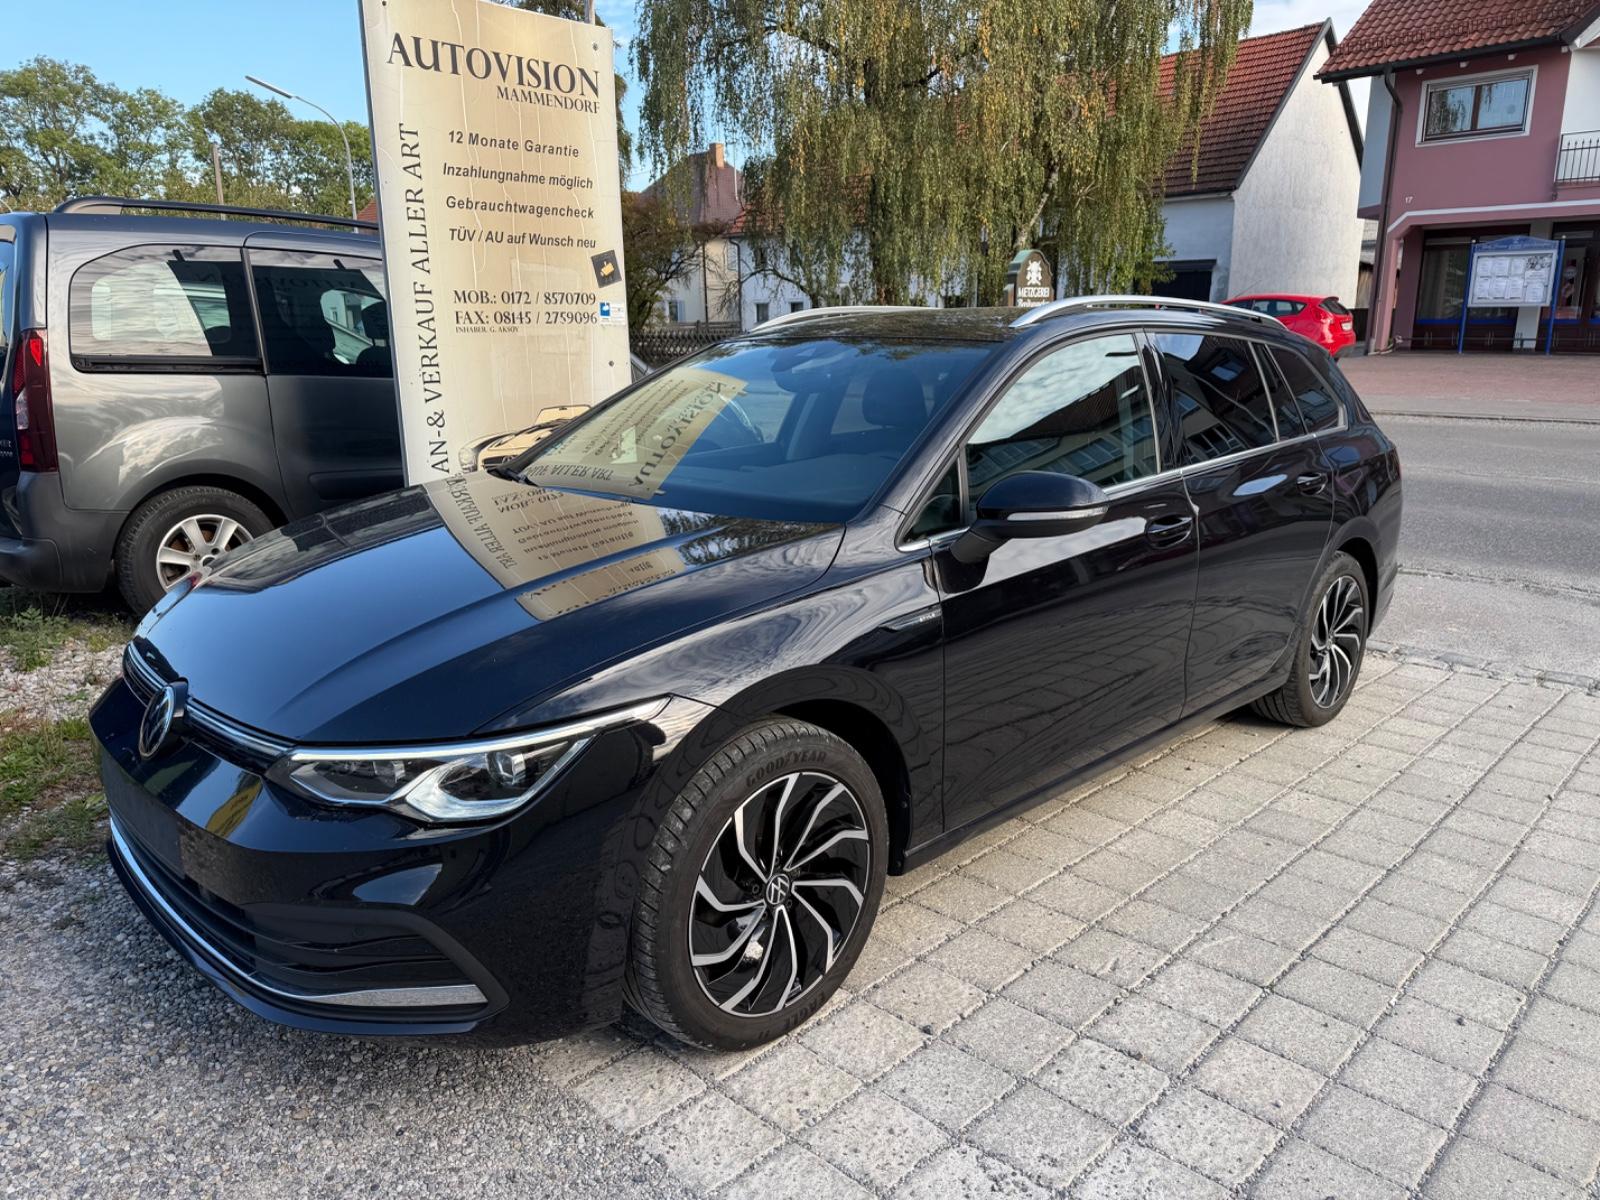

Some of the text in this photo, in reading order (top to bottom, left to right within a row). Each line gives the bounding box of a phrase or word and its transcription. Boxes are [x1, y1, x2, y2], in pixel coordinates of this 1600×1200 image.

[386, 32, 599, 98] AUTOVISION
[496, 85, 600, 114] MAMMENDORF
[398, 122, 423, 179] ART
[448, 130, 580, 158] 12 Monate Garantie
[442, 163, 594, 191] Inzahlungnahme möglich
[446, 196, 595, 220] Gebrauchtwagencheck
[404, 187, 431, 274] ALLER
[449, 226, 597, 249] TÜV / AU auf Wunsch neu
[453, 289, 597, 306] MOB.: 0172 / 8570709
[455, 310, 490, 325] FAX:
[493, 310, 532, 325] 08145
[535, 311, 541, 325] /
[544, 311, 598, 325] 2759096
[412, 281, 444, 403] VERKAUF
